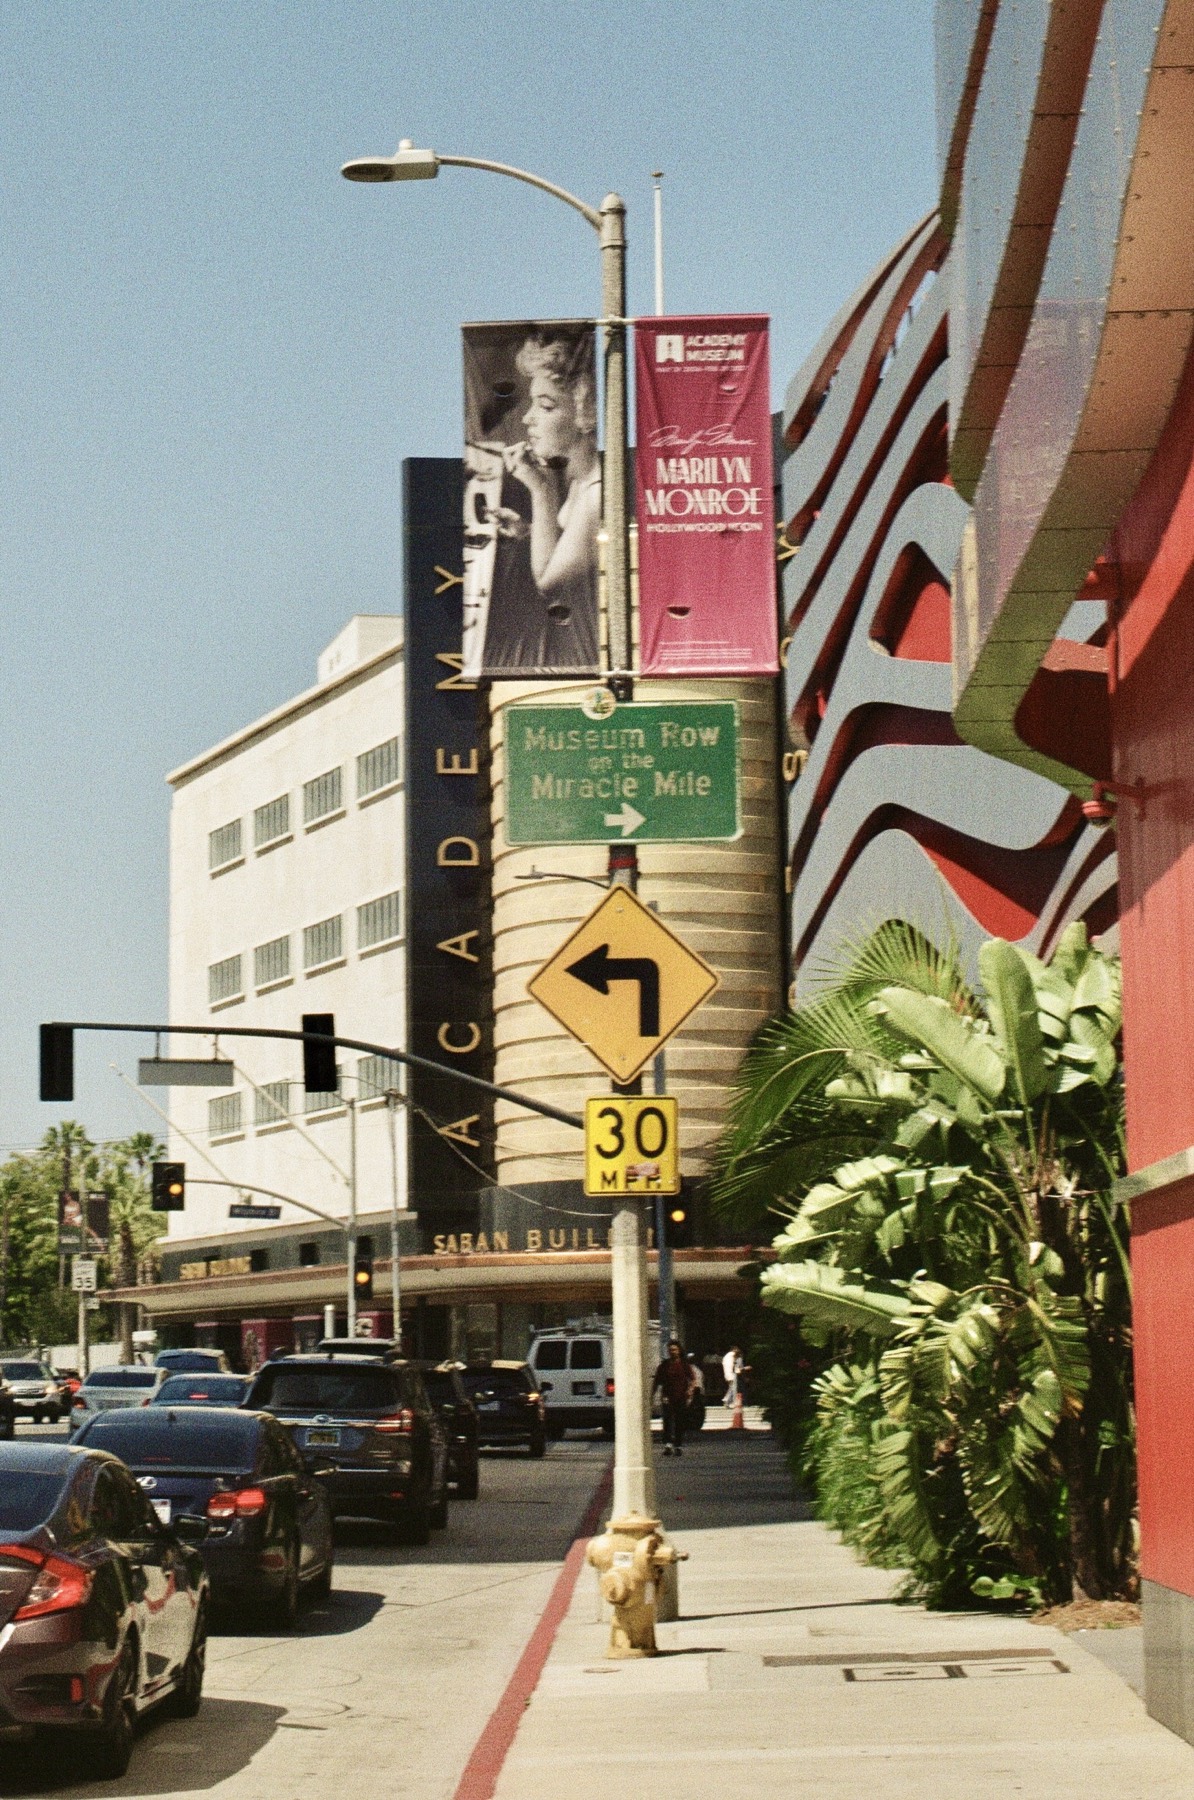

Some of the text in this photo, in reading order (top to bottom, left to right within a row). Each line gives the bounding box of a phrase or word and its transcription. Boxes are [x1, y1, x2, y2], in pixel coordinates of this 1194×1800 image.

[685, 333, 747, 347] ACADEMY
[685, 348, 745, 362] MUSEUM
[656, 456, 751, 485] MARILYN
[644, 487, 763, 517] MONROE
[646, 522, 727, 534] HOLLYWOOD
[525, 722, 720, 750] Museum Row
[588, 751, 656, 771] on the
[532, 770, 711, 799] Miracle Mile
[434, 566, 481, 1147] ACADEMY
[595, 1106, 668, 1160] 30
[433, 1226, 654, 1255] SABAN BUIL
